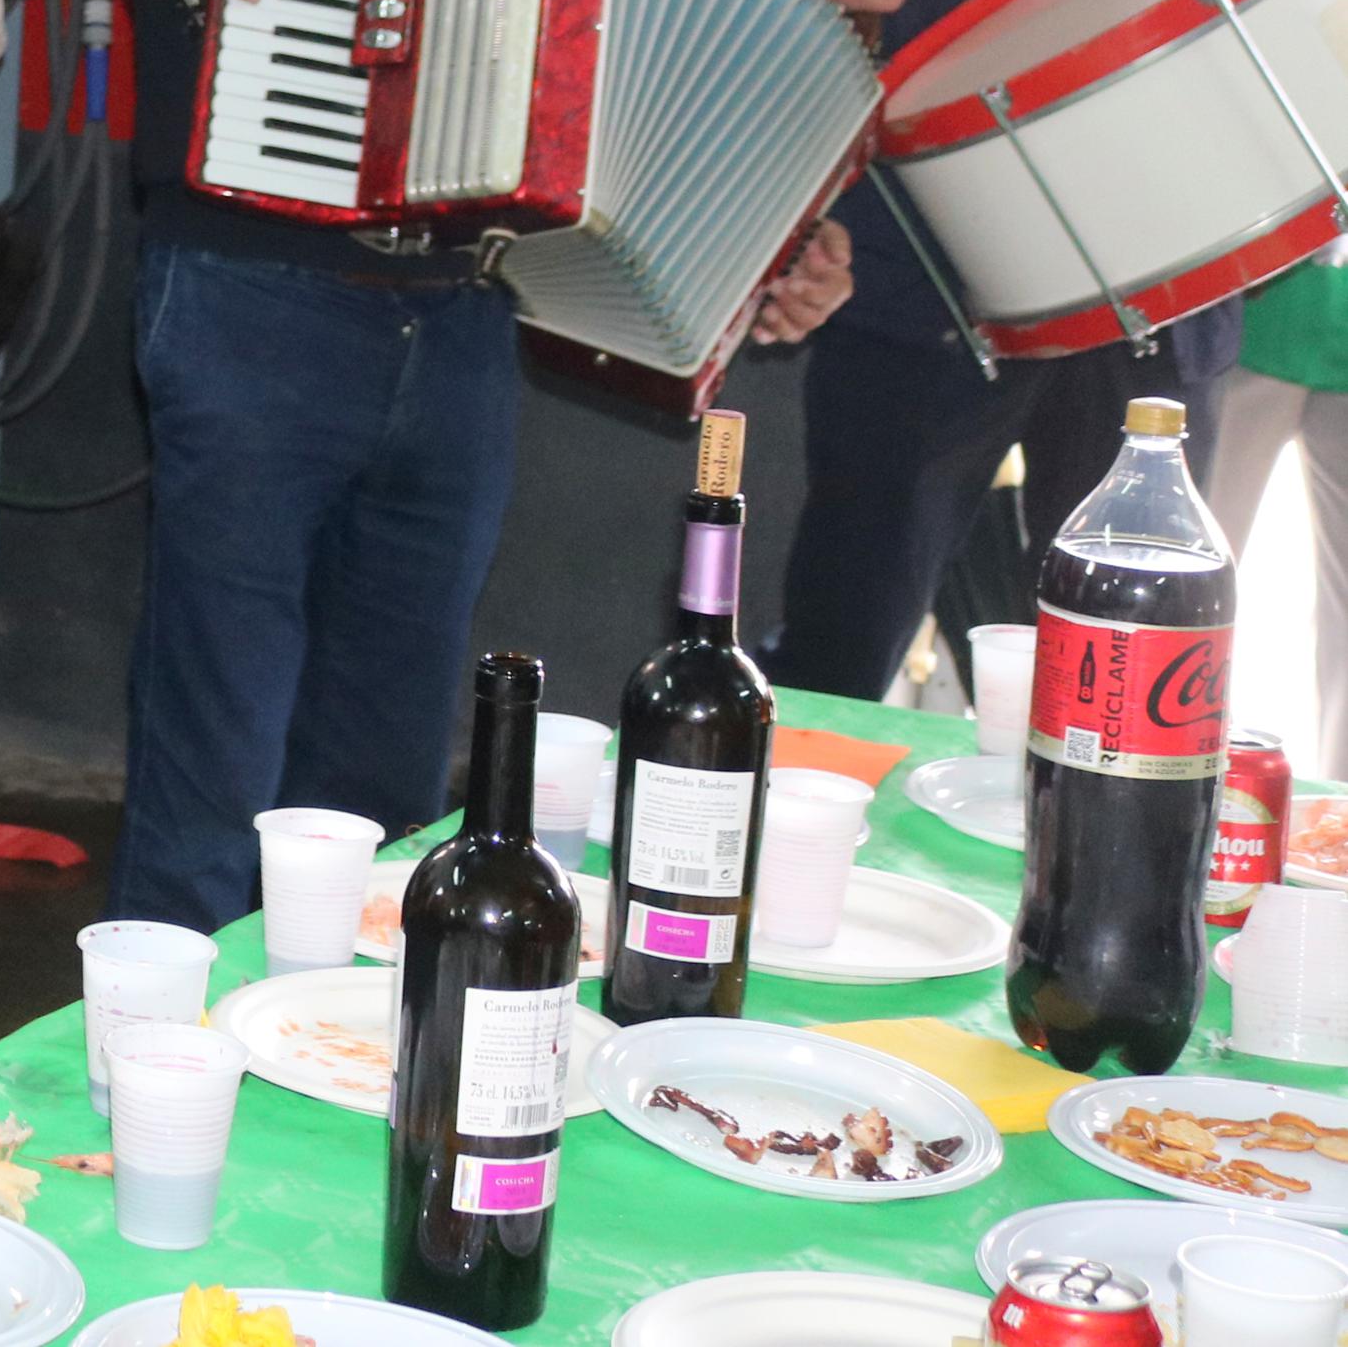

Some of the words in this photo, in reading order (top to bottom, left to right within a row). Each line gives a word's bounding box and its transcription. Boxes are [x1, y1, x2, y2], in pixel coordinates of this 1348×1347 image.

[711, 431, 730, 495] Rodero
[647, 769, 695, 788] Carmelo
[697, 776, 738, 792] Rodero
[1212, 829, 1266, 857] hou
[655, 924, 696, 937] COSECHA
[483, 997, 539, 1014] Carmelo
[470, 1081, 484, 1099] 75
[494, 1175, 536, 1187] COSECHA
